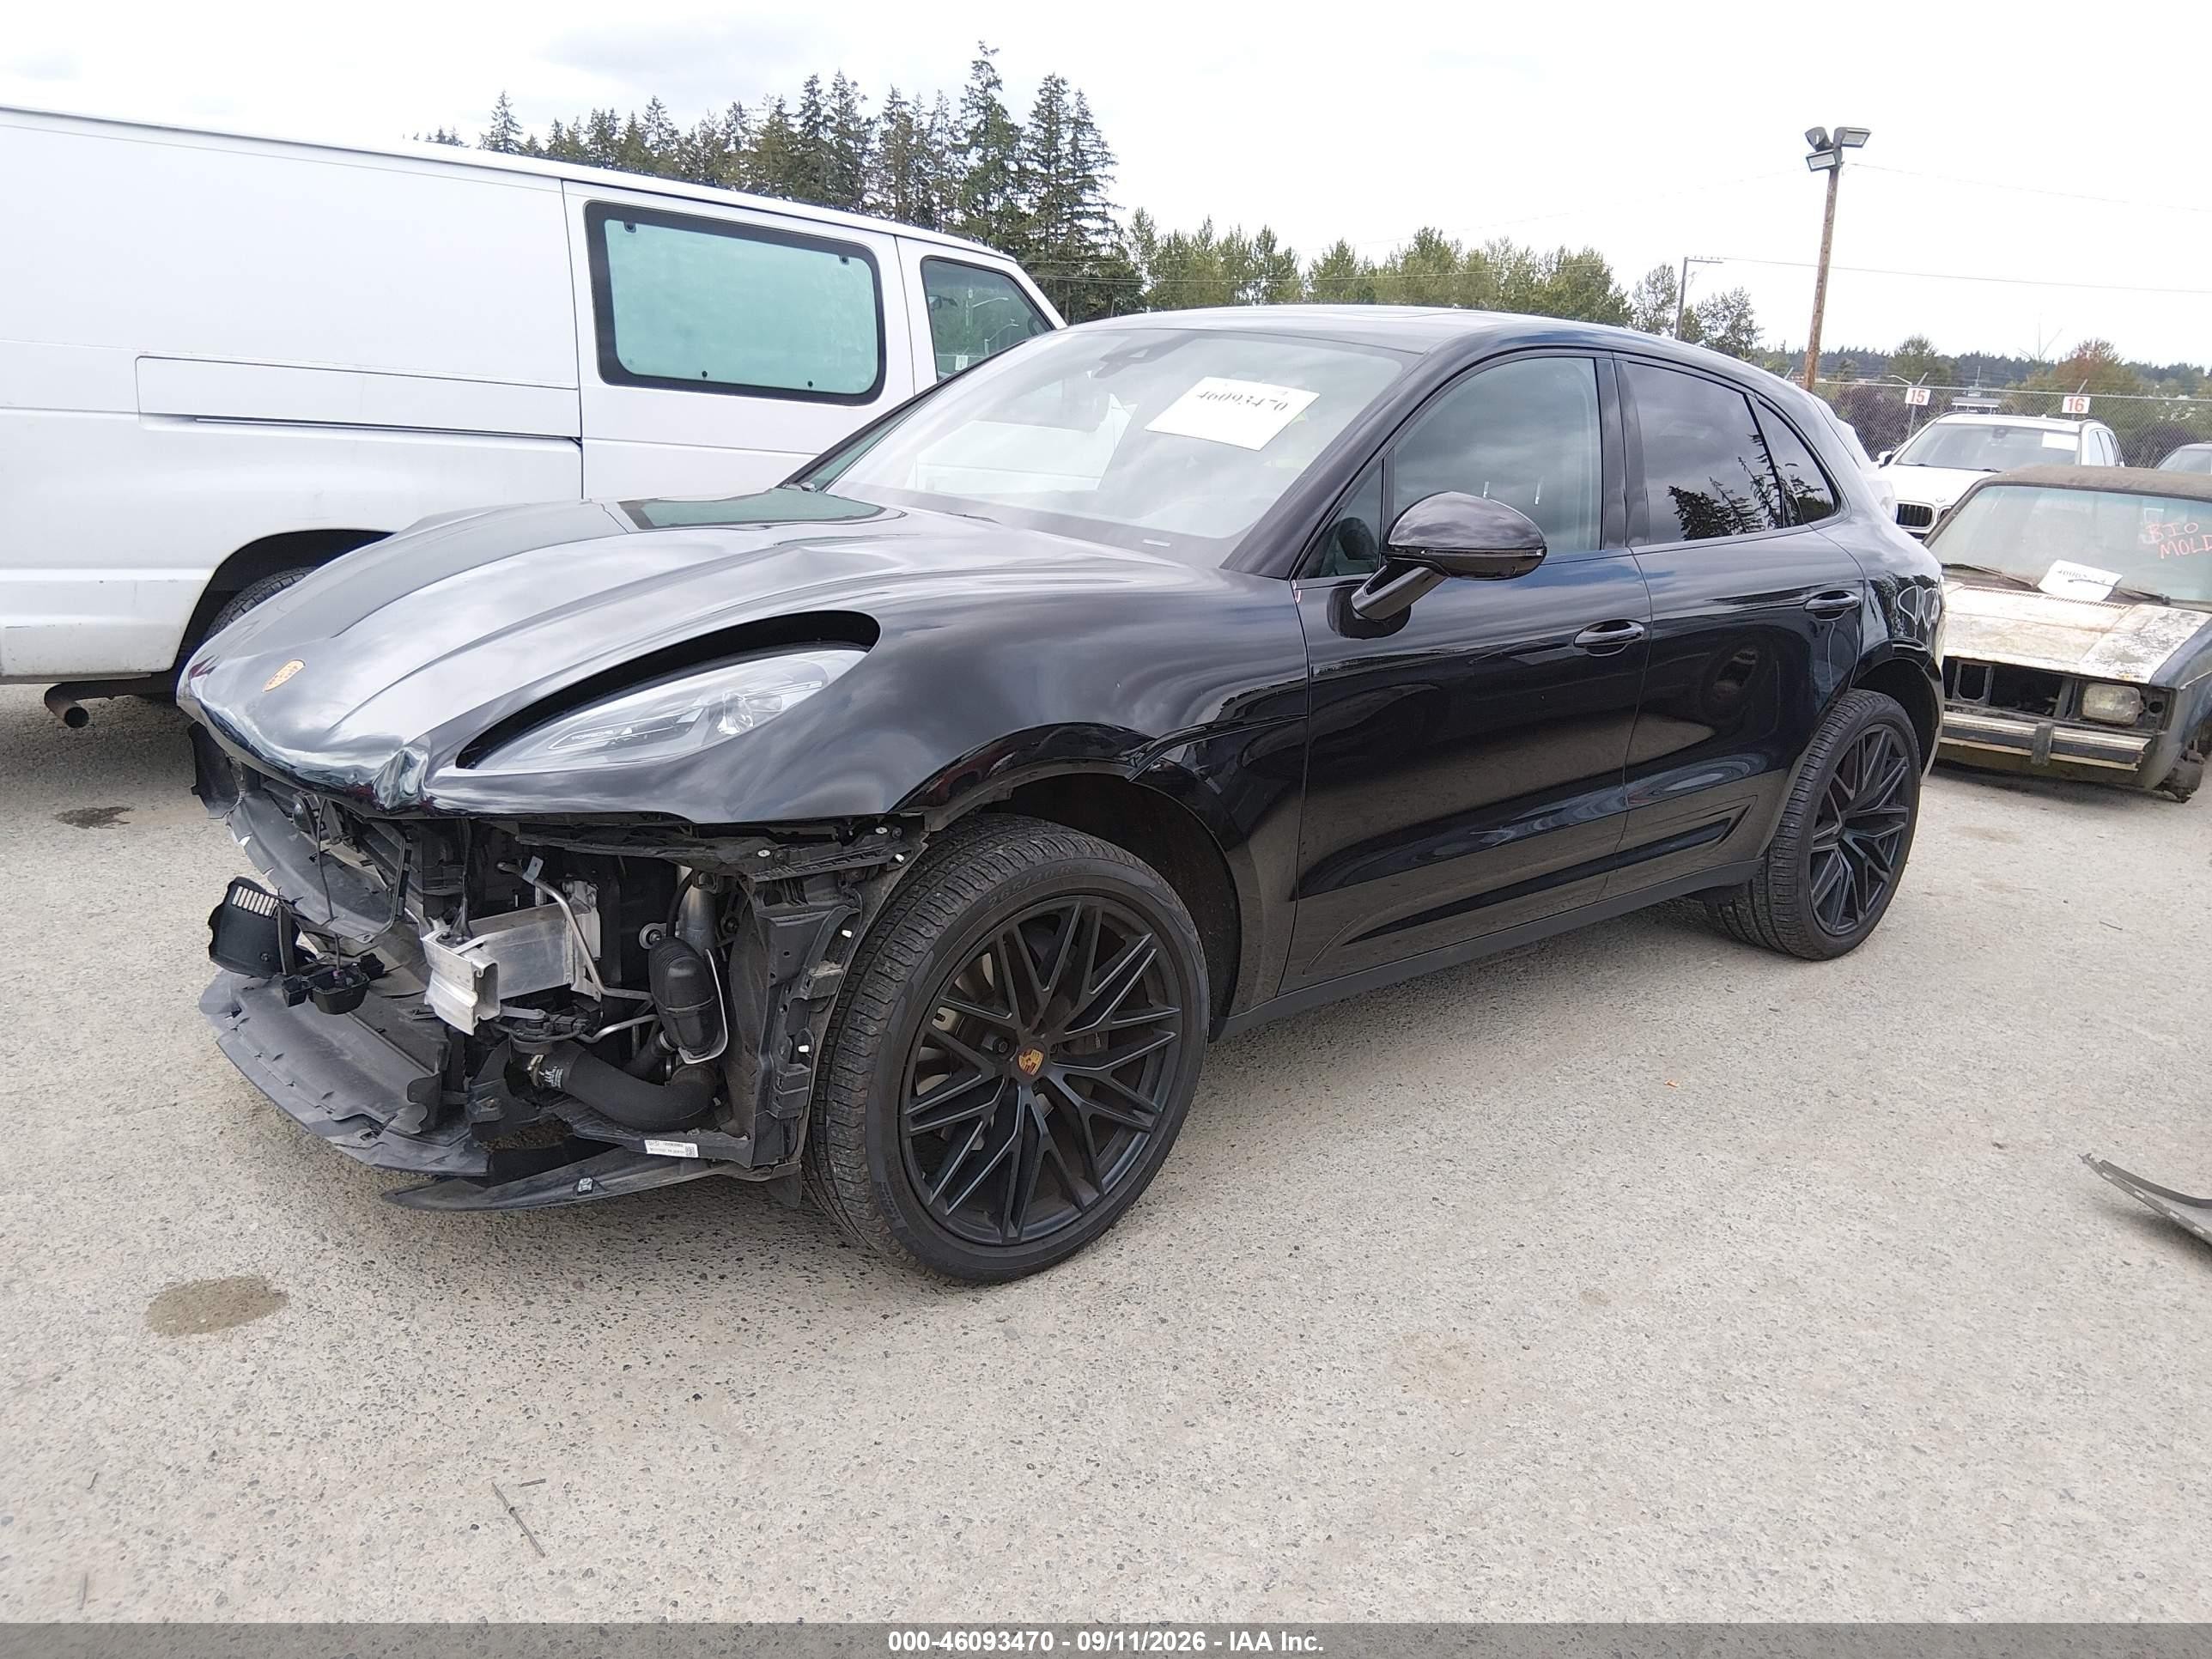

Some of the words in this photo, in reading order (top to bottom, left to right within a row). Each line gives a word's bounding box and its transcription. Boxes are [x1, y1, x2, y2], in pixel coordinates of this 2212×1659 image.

[1910, 389, 1925, 404] 15
[2068, 398, 2085, 412] 16
[2145, 521, 2199, 544] BIO
